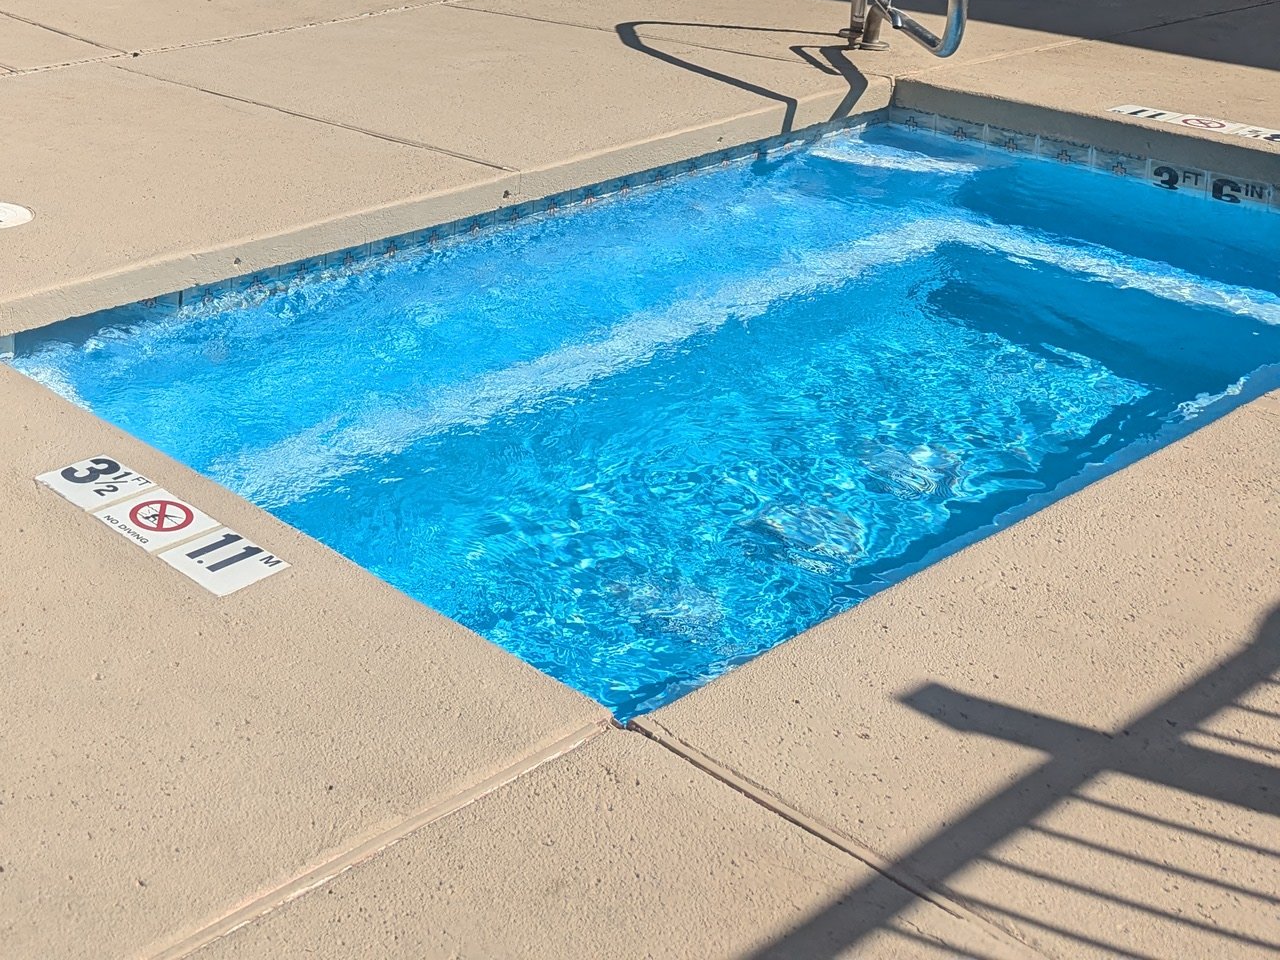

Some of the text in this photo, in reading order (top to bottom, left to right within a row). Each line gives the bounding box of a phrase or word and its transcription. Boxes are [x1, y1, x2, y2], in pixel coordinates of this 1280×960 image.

[1153, 166, 1264, 204] 3 FT 6 IN
[131, 476, 152, 487] FT
[104, 514, 149, 544] NO DIVING
[259, 555, 282, 568] M
